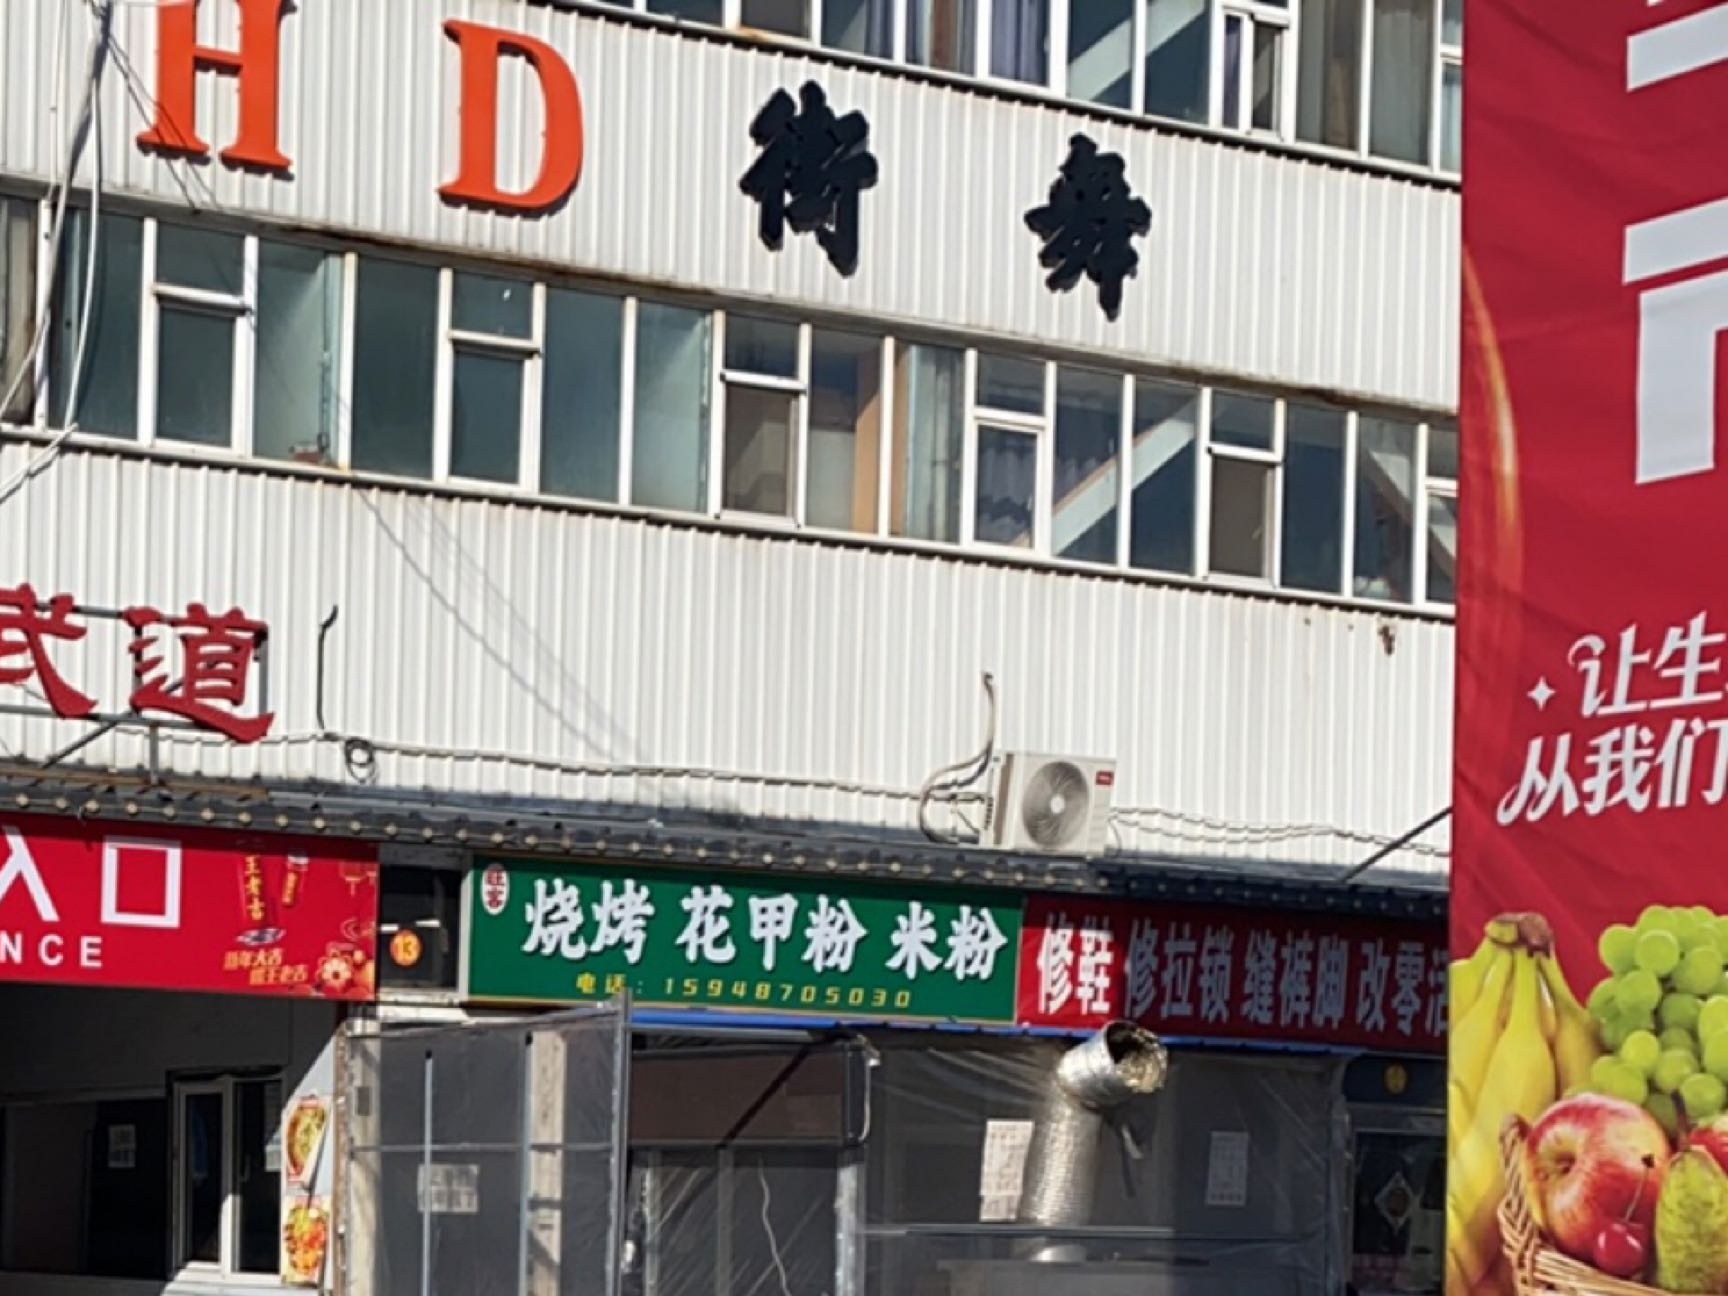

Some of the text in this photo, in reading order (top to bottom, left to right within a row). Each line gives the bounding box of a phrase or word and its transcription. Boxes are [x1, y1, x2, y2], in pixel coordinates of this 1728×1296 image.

[1568, 611, 1728, 718] 让生
[1497, 717, 1728, 827] 从我们
[522, 878, 1008, 981] 烧烤 花甲粉 米粉
[1037, 912, 1115, 1016] 修鞋
